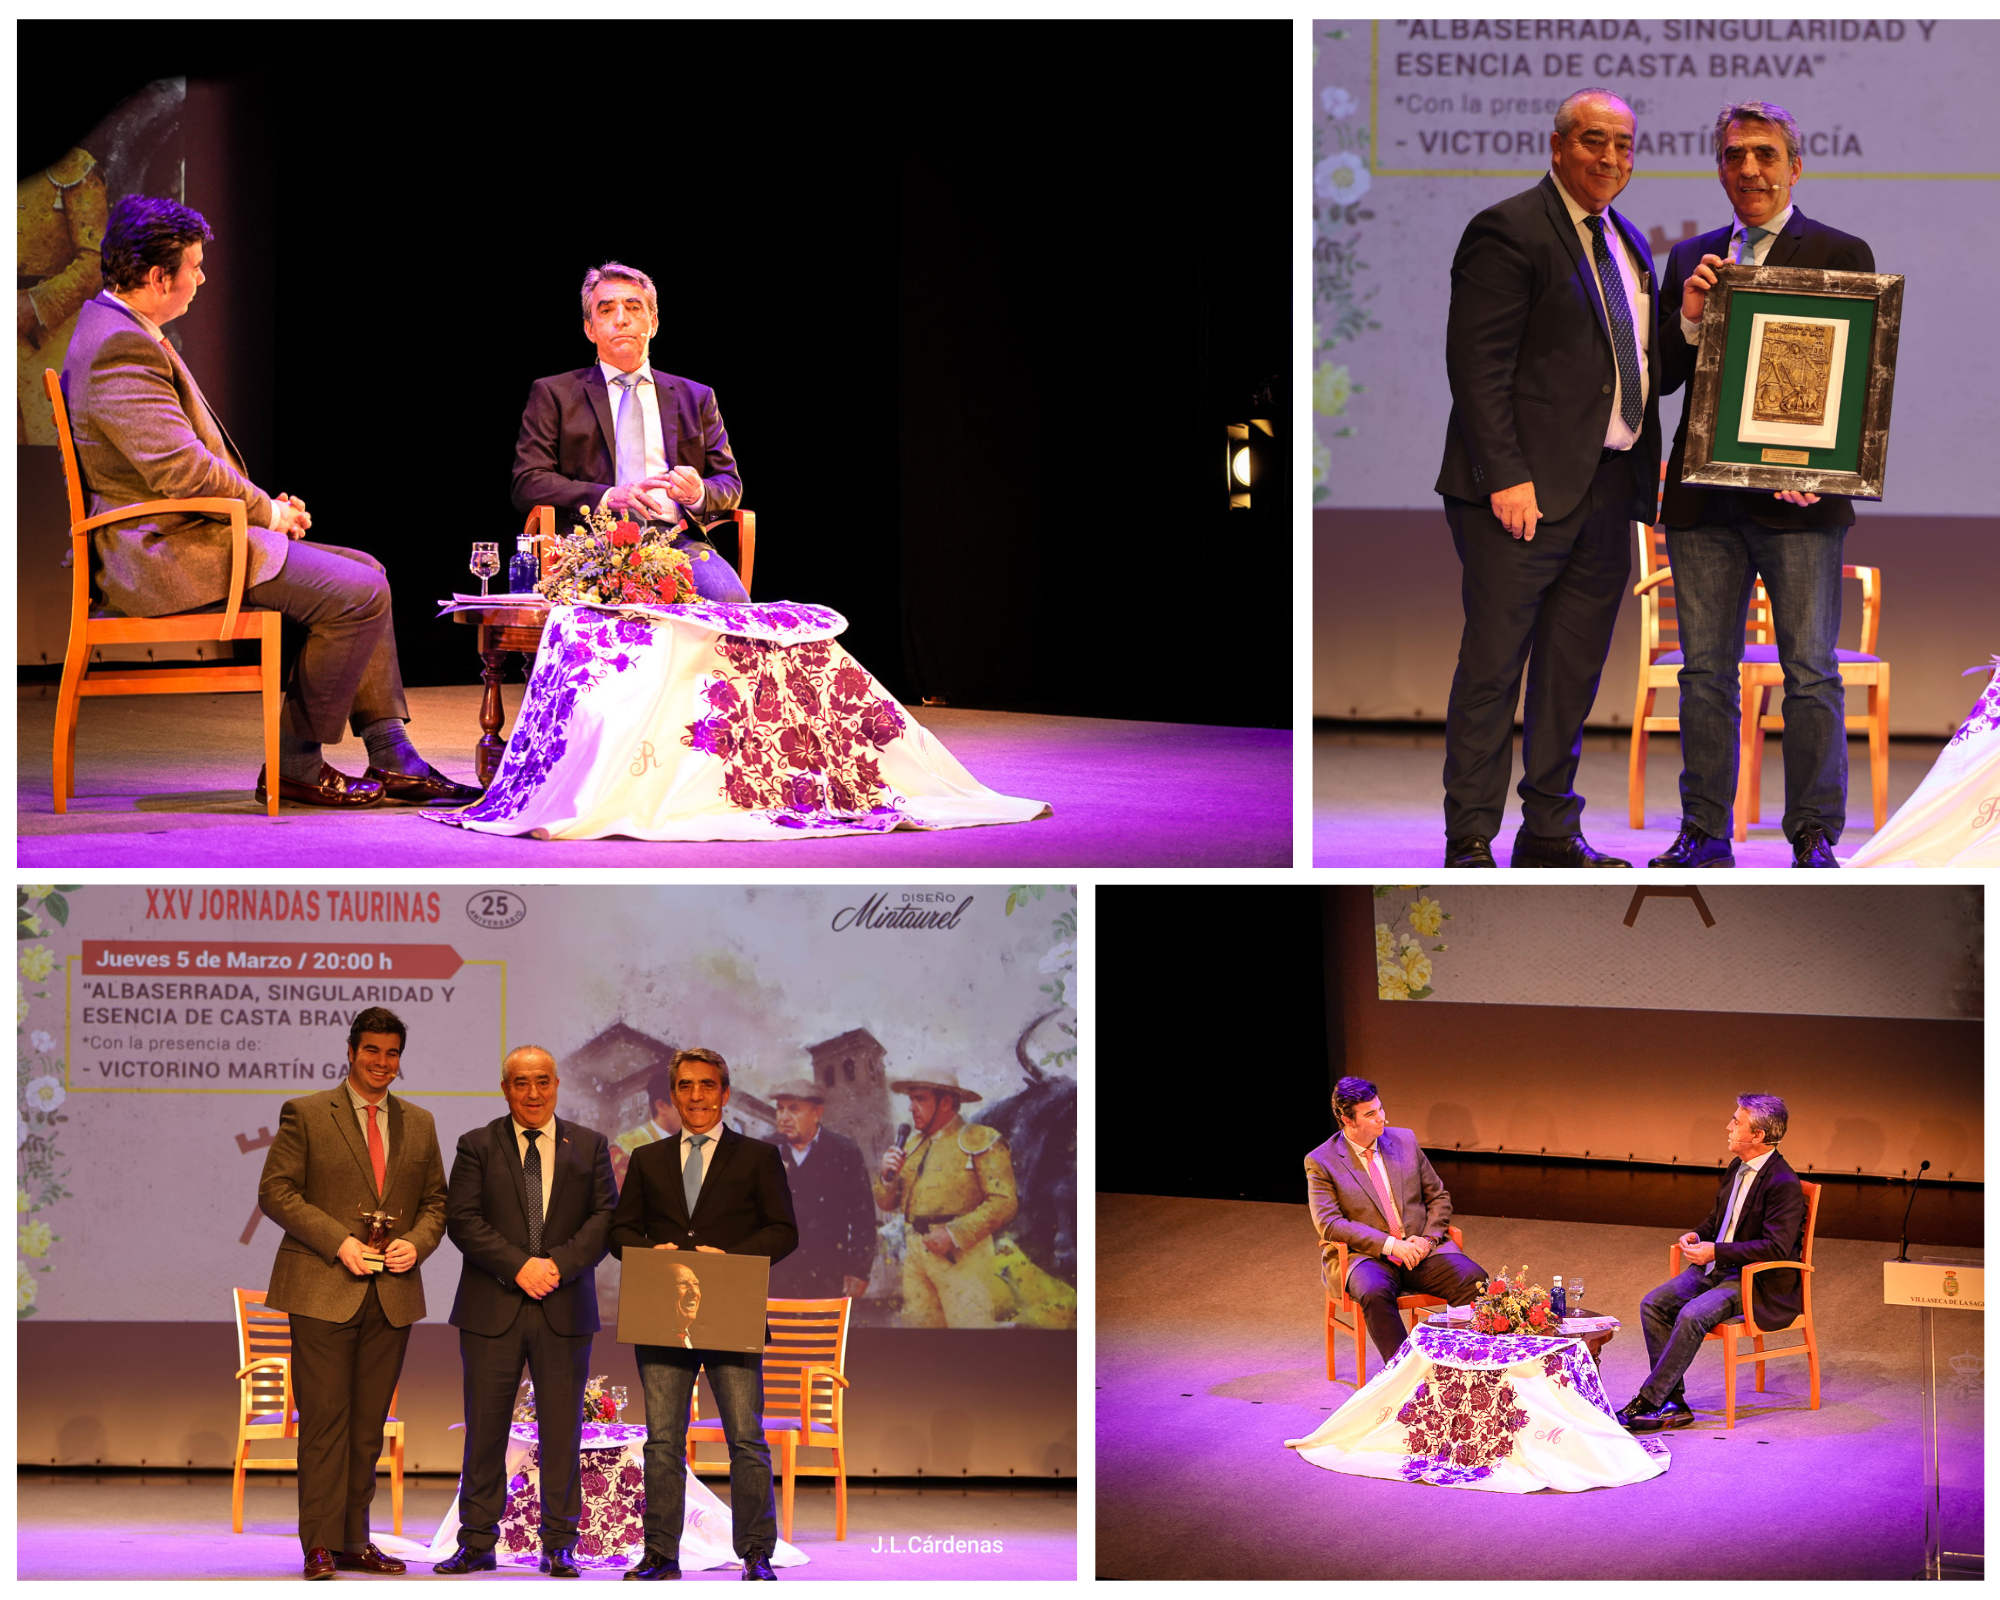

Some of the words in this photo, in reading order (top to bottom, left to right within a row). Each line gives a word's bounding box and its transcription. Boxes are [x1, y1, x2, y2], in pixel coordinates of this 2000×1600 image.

[1664, 19, 1905, 42] SINGULARIDAD
[1916, 19, 1938, 42] Y
[1396, 54, 1532, 77] ESENCIA
[1544, 54, 1582, 77] DE
[1594, 54, 1698, 77] CASTA
[1462, 93, 1482, 114] la
[1490, 97, 1558, 119] prese
[1418, 131, 1545, 154] VICTORI
[1635, 124, 1717, 156] ARTÍ
[145, 888, 193, 920] XXV
[199, 889, 320, 922] JORNADAS
[327, 891, 441, 923] TAURINAS
[481, 895, 508, 916] 25
[902, 891, 955, 903] DISEÑO
[469, 909, 523, 927] ANIVERSARIO
[831, 892, 974, 932] Mintaurel
[96, 950, 170, 968] Jueves
[176, 951, 190, 968] 5
[196, 950, 221, 968] de
[227, 952, 292, 969] Marzo
[297, 953, 308, 970] /
[313, 953, 374, 970] 20:00
[379, 953, 392, 970] h
[268, 985, 434, 1003] SINGULARIDAD
[441, 987, 455, 1003] Y
[83, 1007, 177, 1024] ESENCIA
[186, 1009, 213, 1025] DE
[220, 1009, 292, 1026] CASTA
[300, 1010, 357, 1026] BRAV
[129, 1035, 143, 1049] la
[149, 1037, 231, 1052] presencia
[236, 1037, 261, 1051] de:
[99, 1061, 220, 1078] VICTORINO
[228, 1057, 314, 1079] MARTÍN
[1910, 1296, 1947, 1304] VILLASECA
